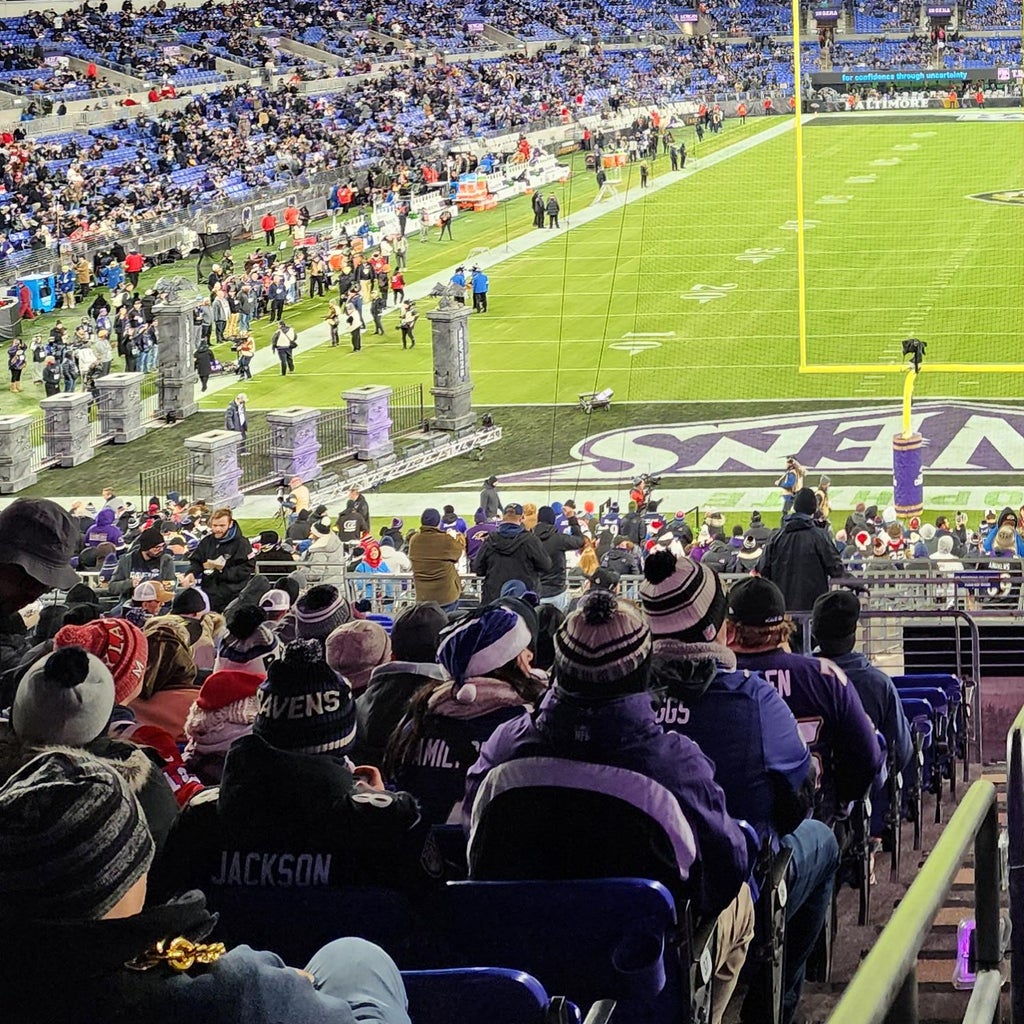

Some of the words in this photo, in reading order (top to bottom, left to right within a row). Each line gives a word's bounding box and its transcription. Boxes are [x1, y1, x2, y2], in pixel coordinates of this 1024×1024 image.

[840, 73, 853, 82] for
[896, 72, 925, 82] through
[926, 71, 968, 80] uncertainty
[680, 282, 739, 300] 20
[608, 330, 676, 350] 10
[700, 489, 895, 509] HTE
[211, 851, 332, 887] JACKSON
